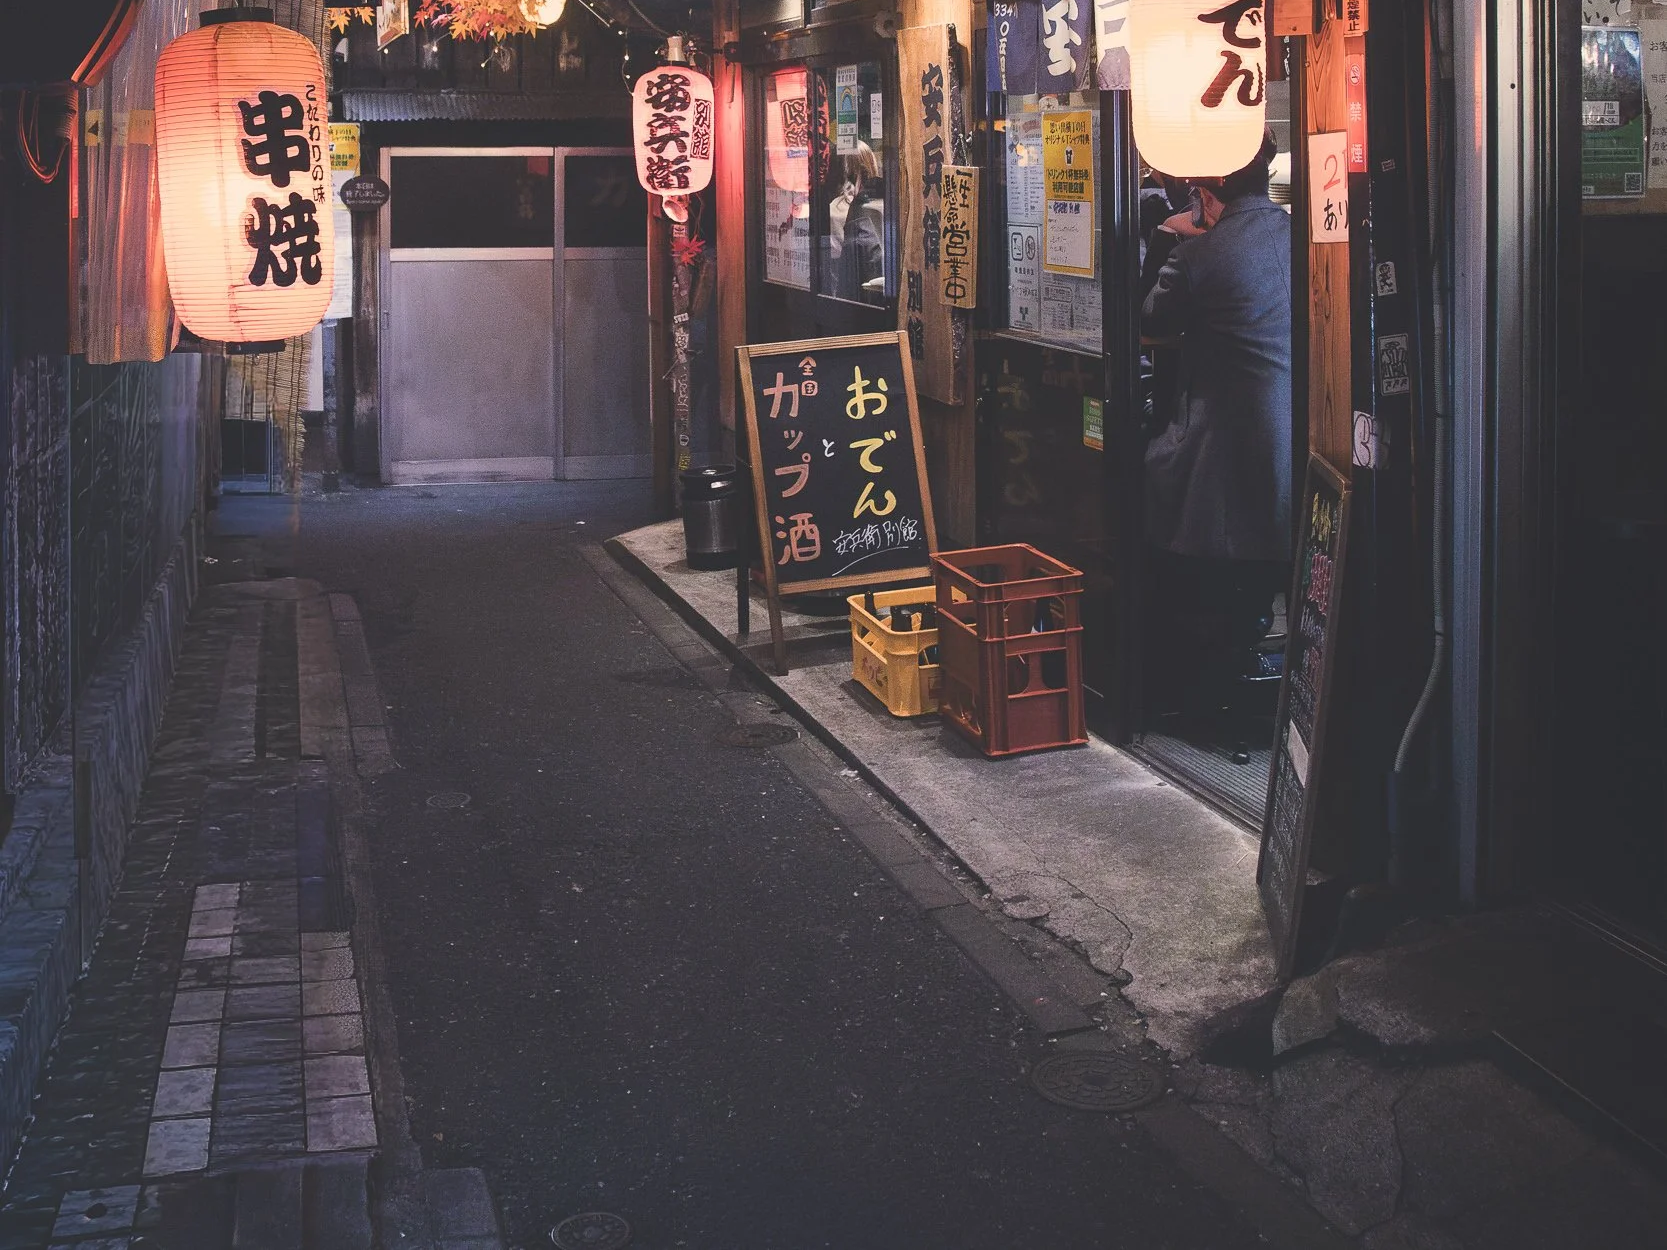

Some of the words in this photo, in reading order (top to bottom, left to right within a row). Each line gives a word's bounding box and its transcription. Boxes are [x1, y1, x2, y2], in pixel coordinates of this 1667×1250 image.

[1349, 102, 1363, 163] 禁煙
[237, 90, 322, 287] 串焼
[798, 356, 818, 396] 全国
[763, 372, 821, 566] カップ酒
[822, 438, 835, 458] と
[845, 365, 897, 519] おでん
